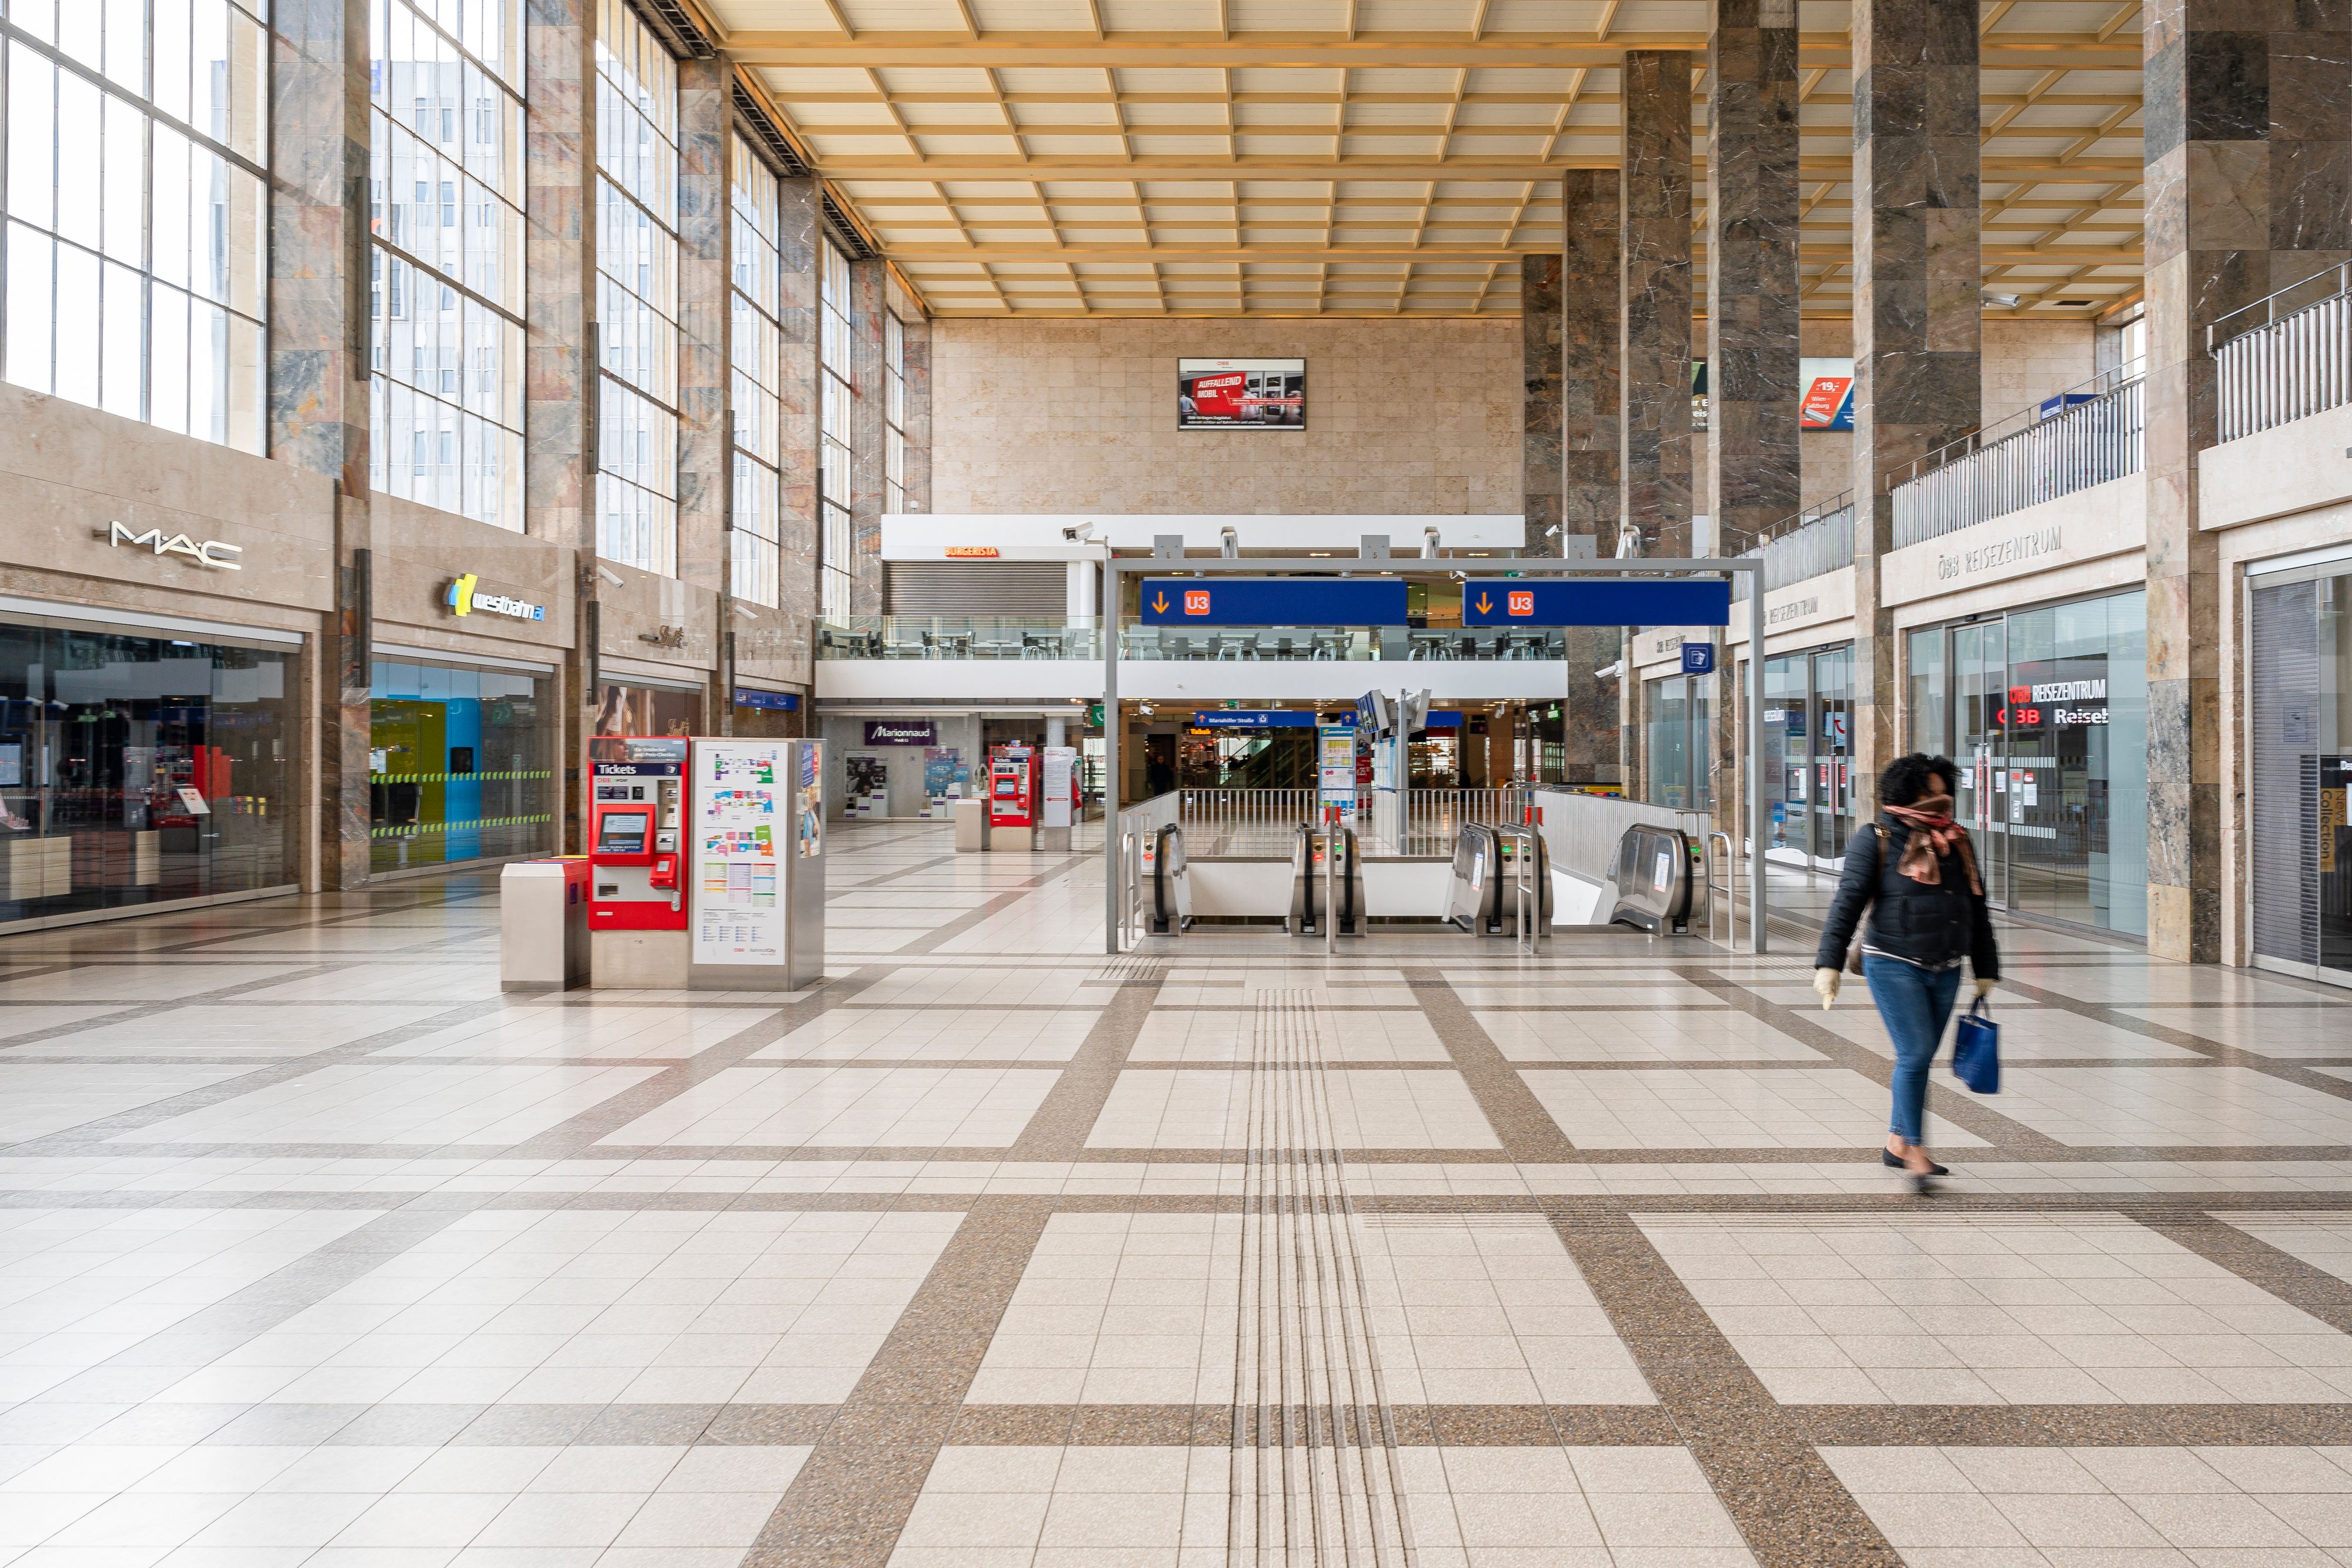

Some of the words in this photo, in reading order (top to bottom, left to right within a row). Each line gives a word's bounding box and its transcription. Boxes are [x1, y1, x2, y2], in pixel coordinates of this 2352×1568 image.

[1197, 376, 1242, 388] AUFFALLEND
[1197, 389, 1218, 398] MOBIL
[945, 547, 998, 557] BURGERISTA
[1938, 554, 1959, 580] ÖBB
[1965, 526, 2061, 573] REISEZENTRUM
[1187, 596, 1208, 610] U3
[1511, 597, 1532, 610] U3
[1770, 596, 1818, 624] REISEZENTRUM
[2009, 685, 2031, 704] ÖBB
[2032, 679, 2106, 703] REISEZENTRUM
[871, 726, 930, 739] Marionnaud
[598, 764, 636, 774] Tickets
[2335, 791, 2346, 822] New
[2321, 790, 2333, 858] Collection
